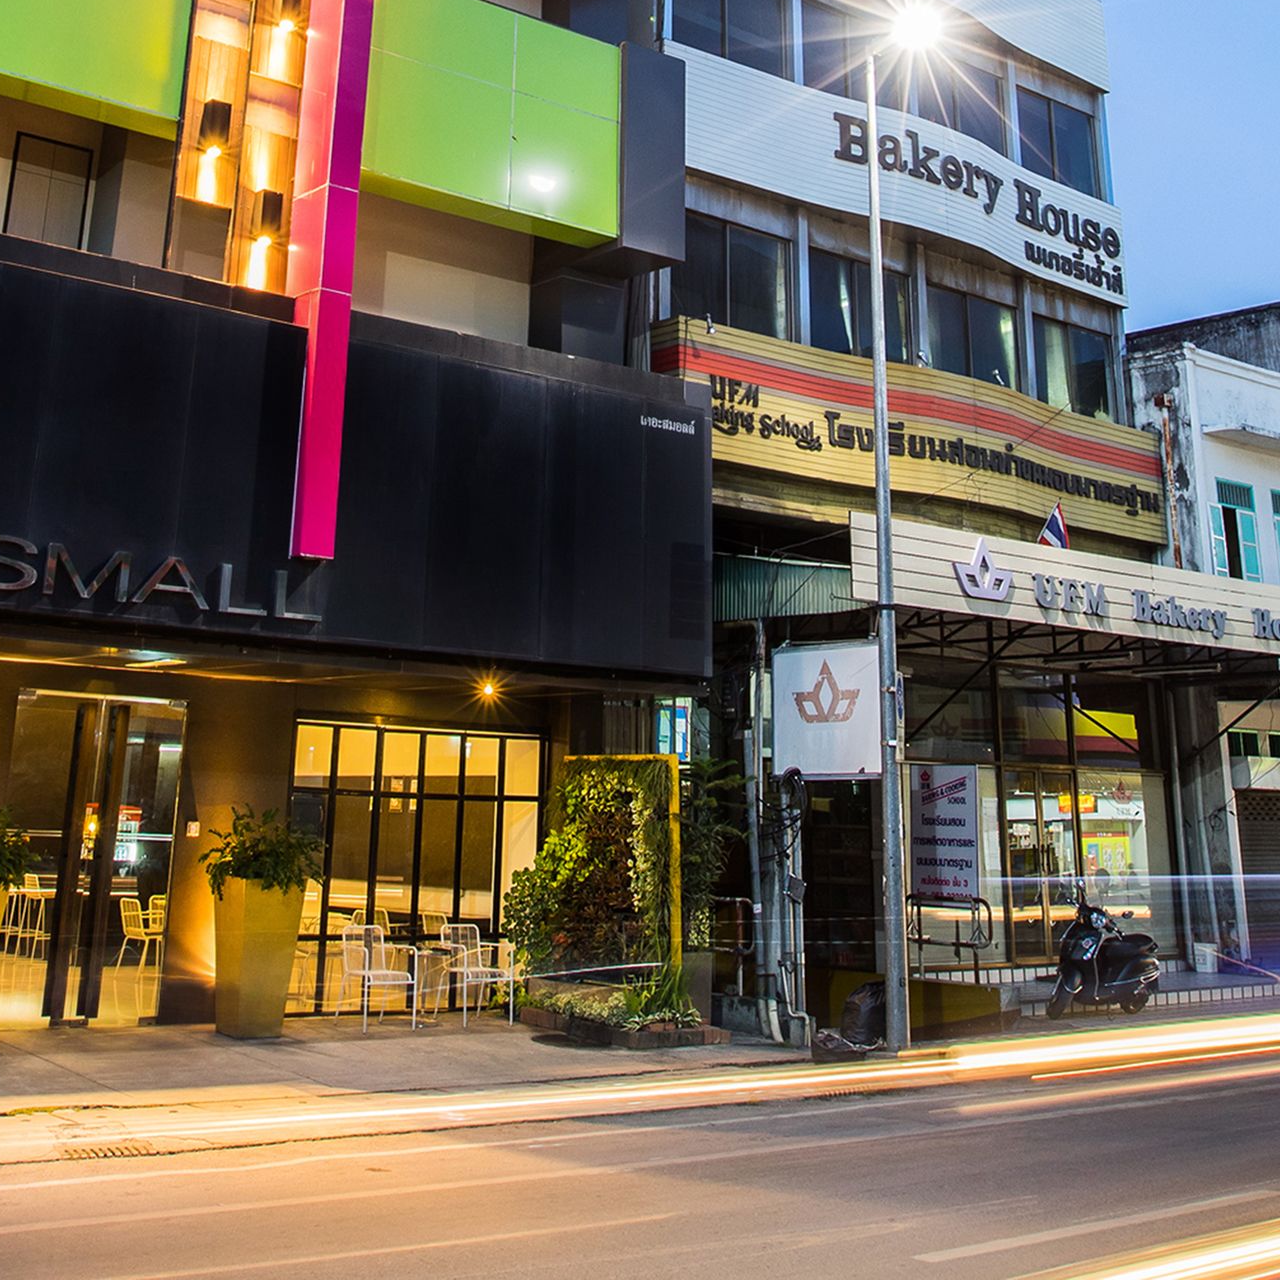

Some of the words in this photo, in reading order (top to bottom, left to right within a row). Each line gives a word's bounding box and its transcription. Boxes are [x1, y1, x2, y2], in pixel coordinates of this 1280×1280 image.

[833, 112, 1004, 215] Bakery
[1013, 178, 1121, 259] House
[710, 374, 760, 408] UFM
[712, 401, 755, 436] aking
[824, 410, 1160, 516] โรงรียนสอนทำขนมอบมาตรฐาน
[1032, 572, 1106, 617] UFM
[1131, 589, 1228, 639] Bakery
[947, 796, 967, 805] SCHOOL
